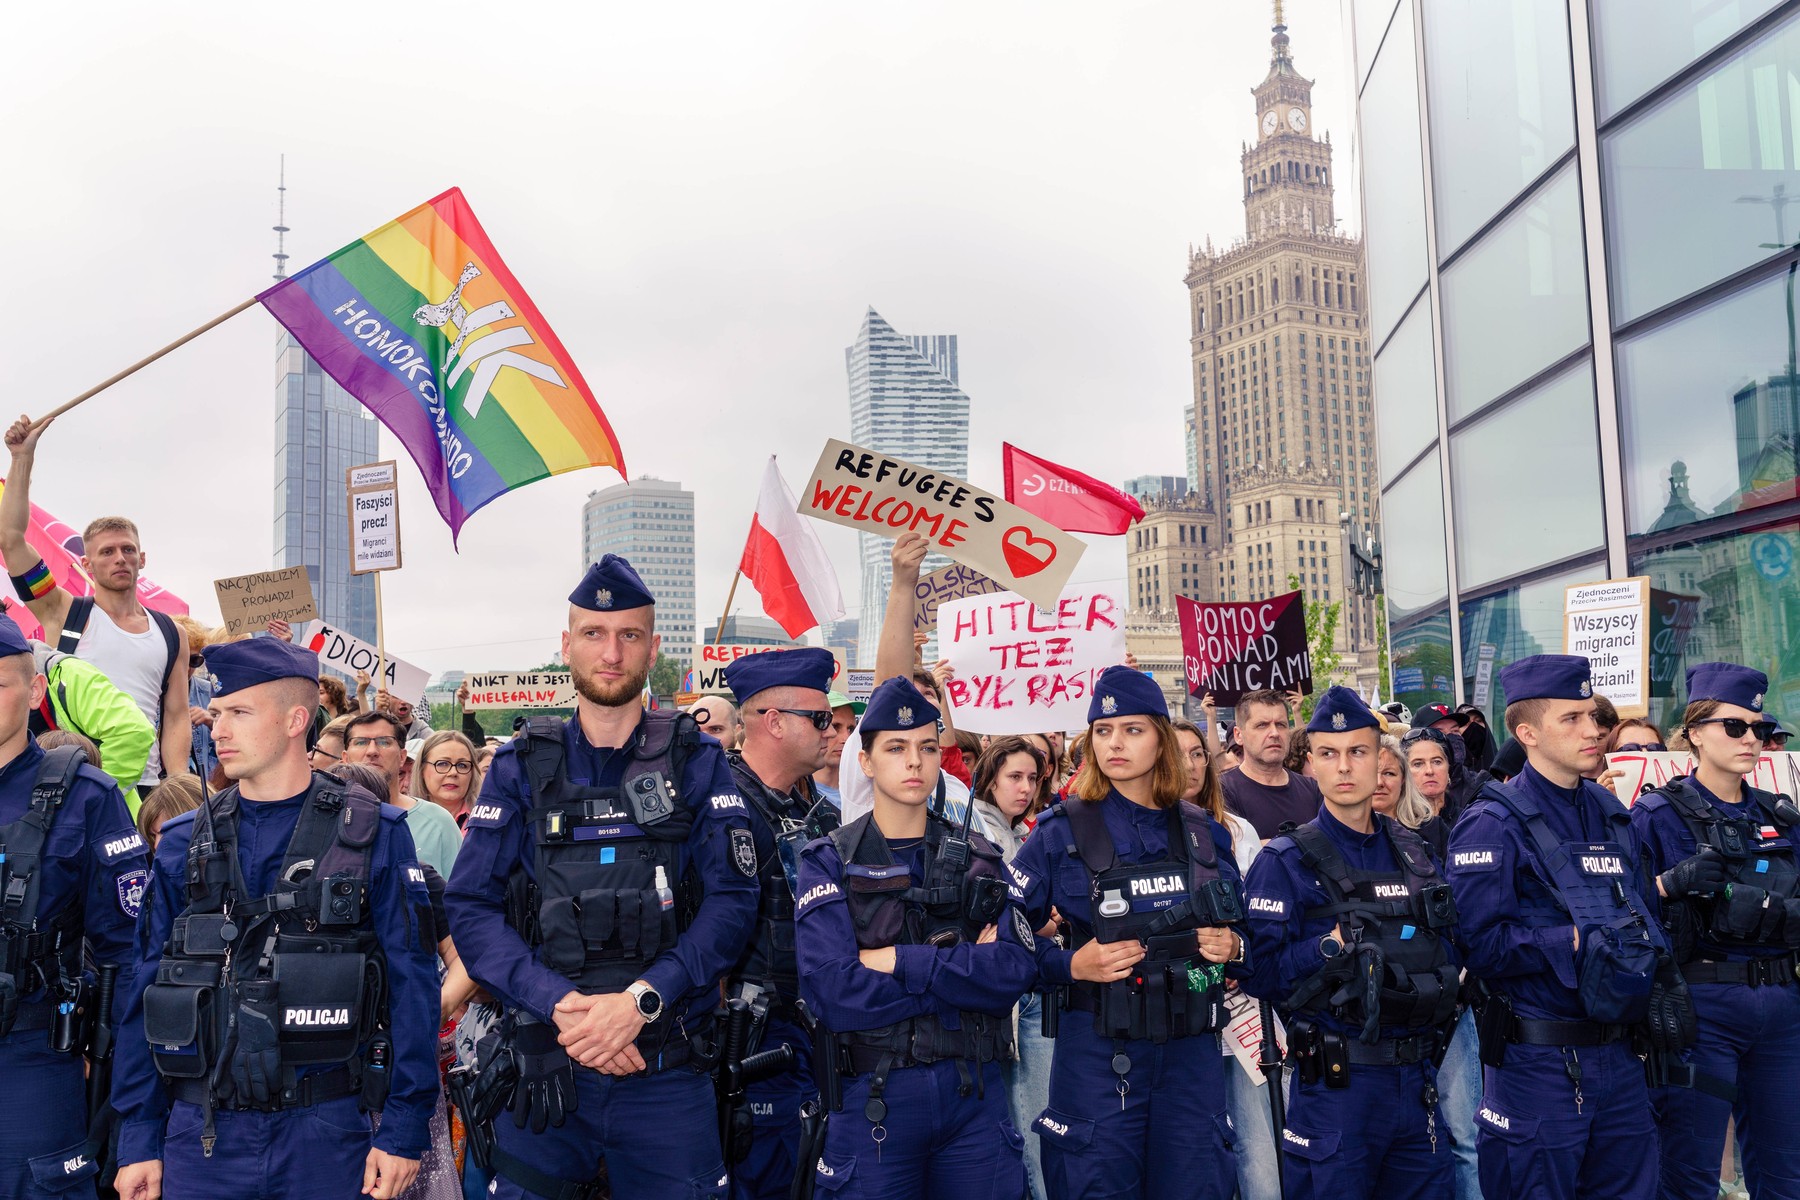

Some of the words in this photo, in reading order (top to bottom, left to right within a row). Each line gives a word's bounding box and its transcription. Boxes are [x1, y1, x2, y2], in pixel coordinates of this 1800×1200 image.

[356, 470, 387, 480] Zjednoczeni
[834, 448, 995, 523] REFUGEES
[356, 493, 393, 511] Faszyści
[811, 479, 969, 548] WELCOME
[361, 514, 388, 533] precz!
[362, 537, 387, 549] Migranci
[357, 552, 369, 560] mile
[370, 549, 394, 559] widziani
[217, 568, 300, 594] NACJONALIZM
[241, 589, 294, 608] PROWADZI
[1571, 597, 1597, 605] Przeciw
[1598, 593, 1635, 602] Rasizmowi
[1576, 585, 1630, 599] Zjednoczeni
[227, 618, 242, 633] DO
[953, 593, 1120, 643] HITLER
[1193, 603, 1276, 636] POMOC
[1573, 613, 1638, 633] Wszyscy
[1197, 633, 1278, 664] PONAD
[1575, 631, 1635, 653] migranci
[1590, 653, 1619, 668] mile
[472, 675, 509, 688] NIKT
[516, 675, 539, 685] NIE
[543, 674, 571, 685] JEST
[1184, 651, 1310, 692] GRANICAMI
[471, 689, 556, 705] NIELEGALNY
[946, 675, 1017, 711] BYŁ
[105, 834, 143, 857] POLICJA
[1455, 851, 1493, 866] POLICJA
[1582, 856, 1624, 874] POLICJA
[1130, 875, 1185, 896] POLICJA
[798, 883, 839, 909] POLICJA
[1248, 897, 1284, 913] POLICJA
[285, 1009, 349, 1026] POLICJA
